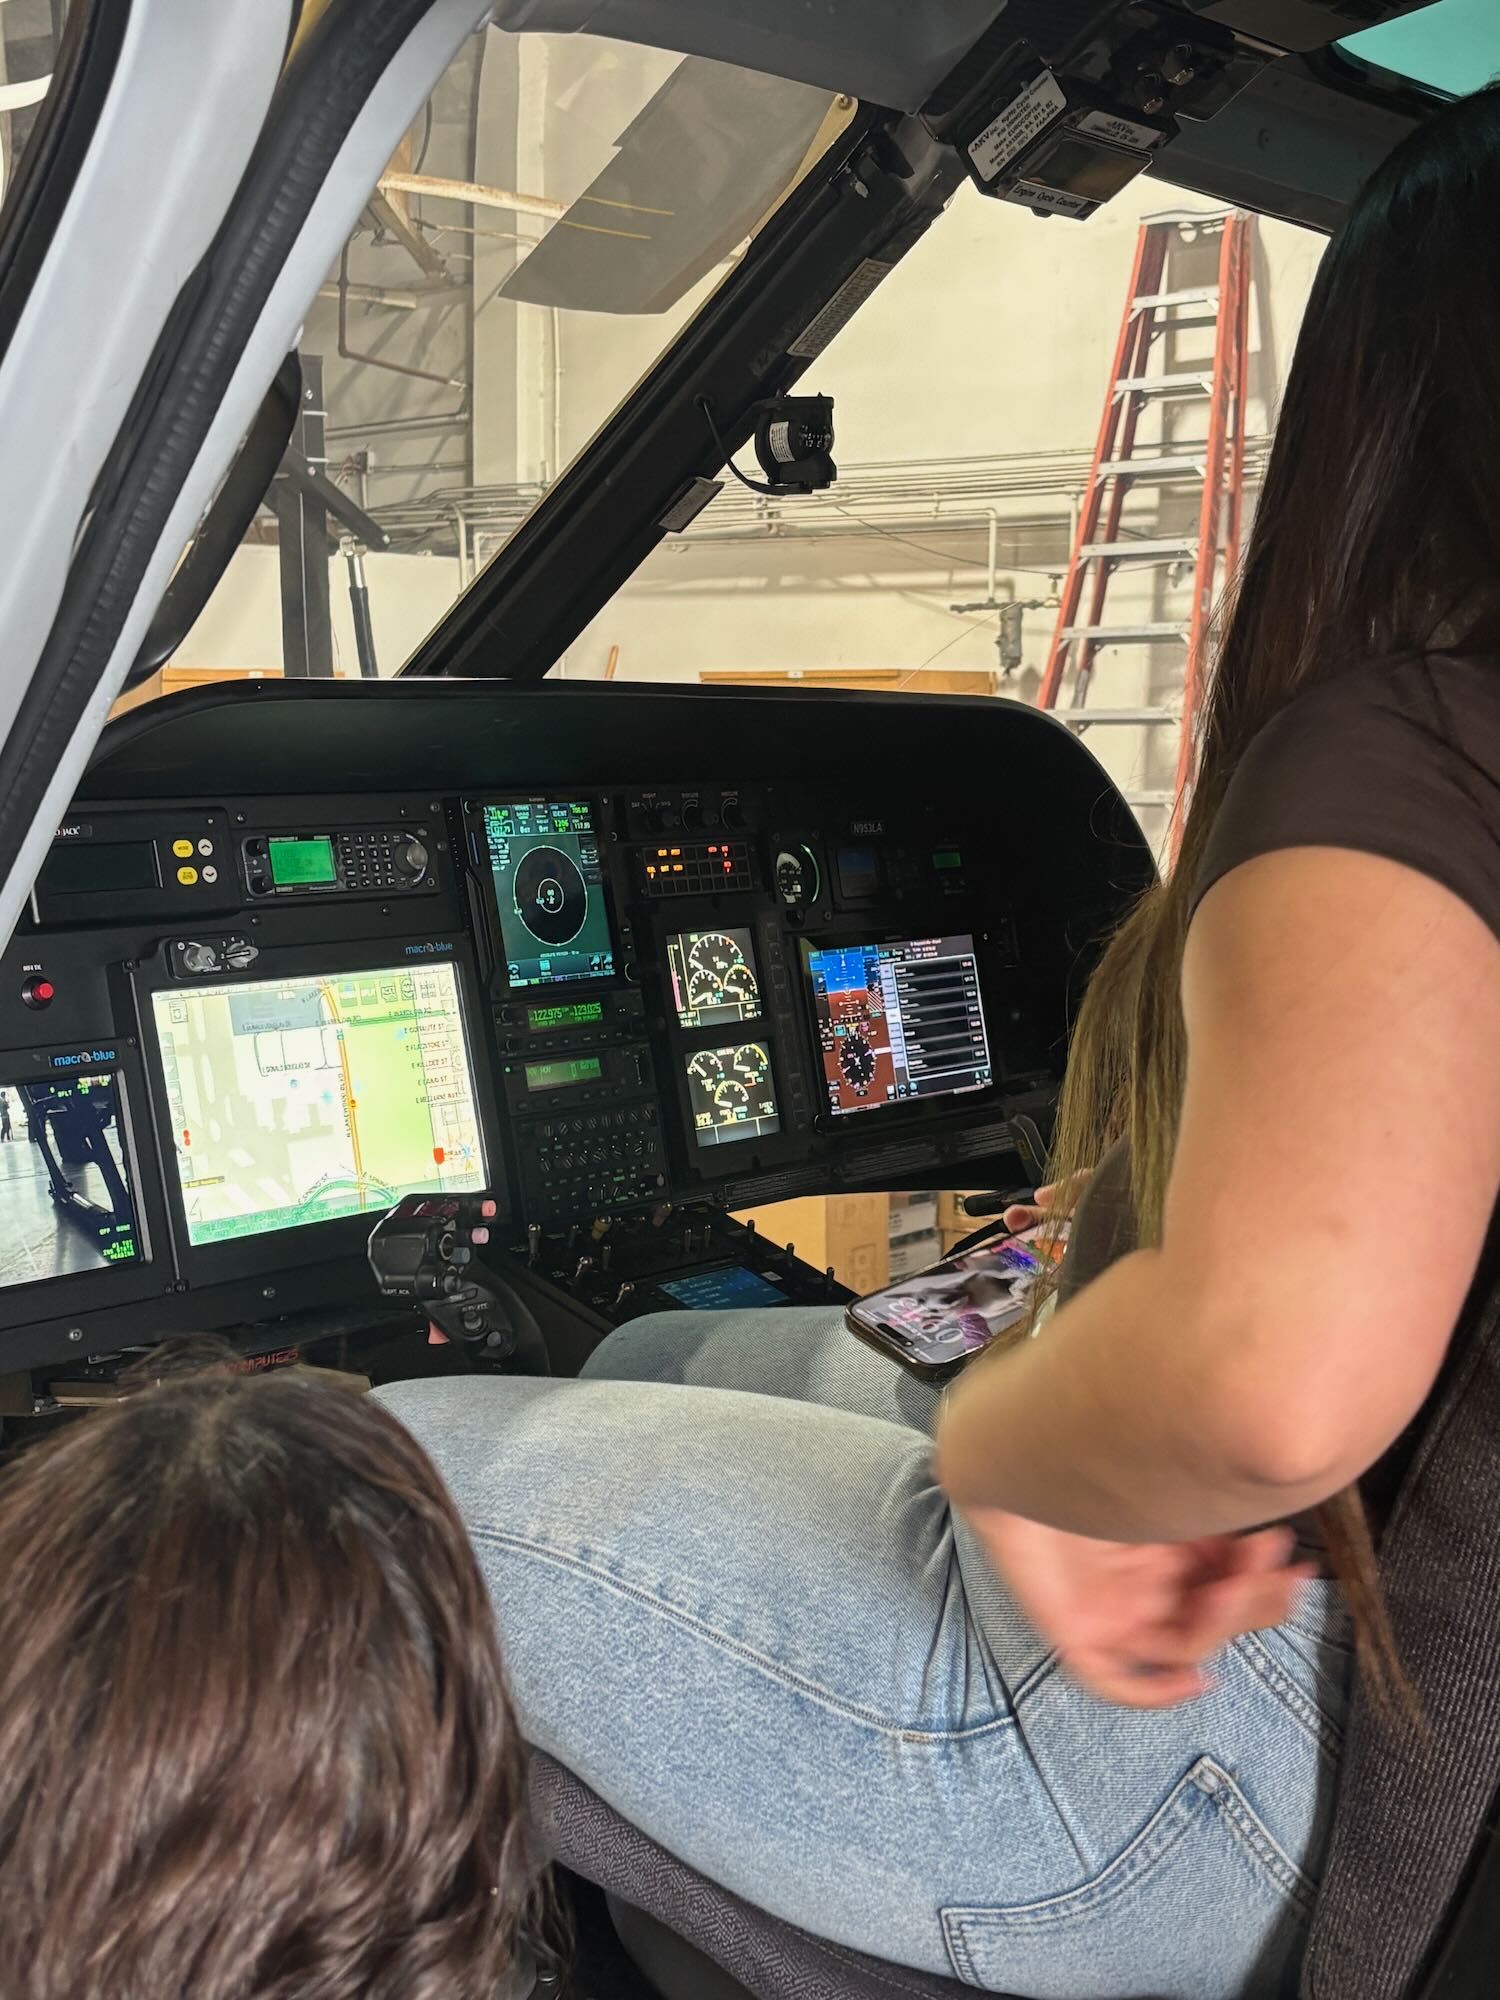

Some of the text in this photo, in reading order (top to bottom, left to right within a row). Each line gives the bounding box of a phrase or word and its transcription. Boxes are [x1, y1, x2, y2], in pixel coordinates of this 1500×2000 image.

[853, 823, 883, 834] N953LA
[533, 1008, 562, 1020] 122.975
[573, 1002, 601, 1016] 123.025
[54, 1050, 116, 1068] macro-blue
